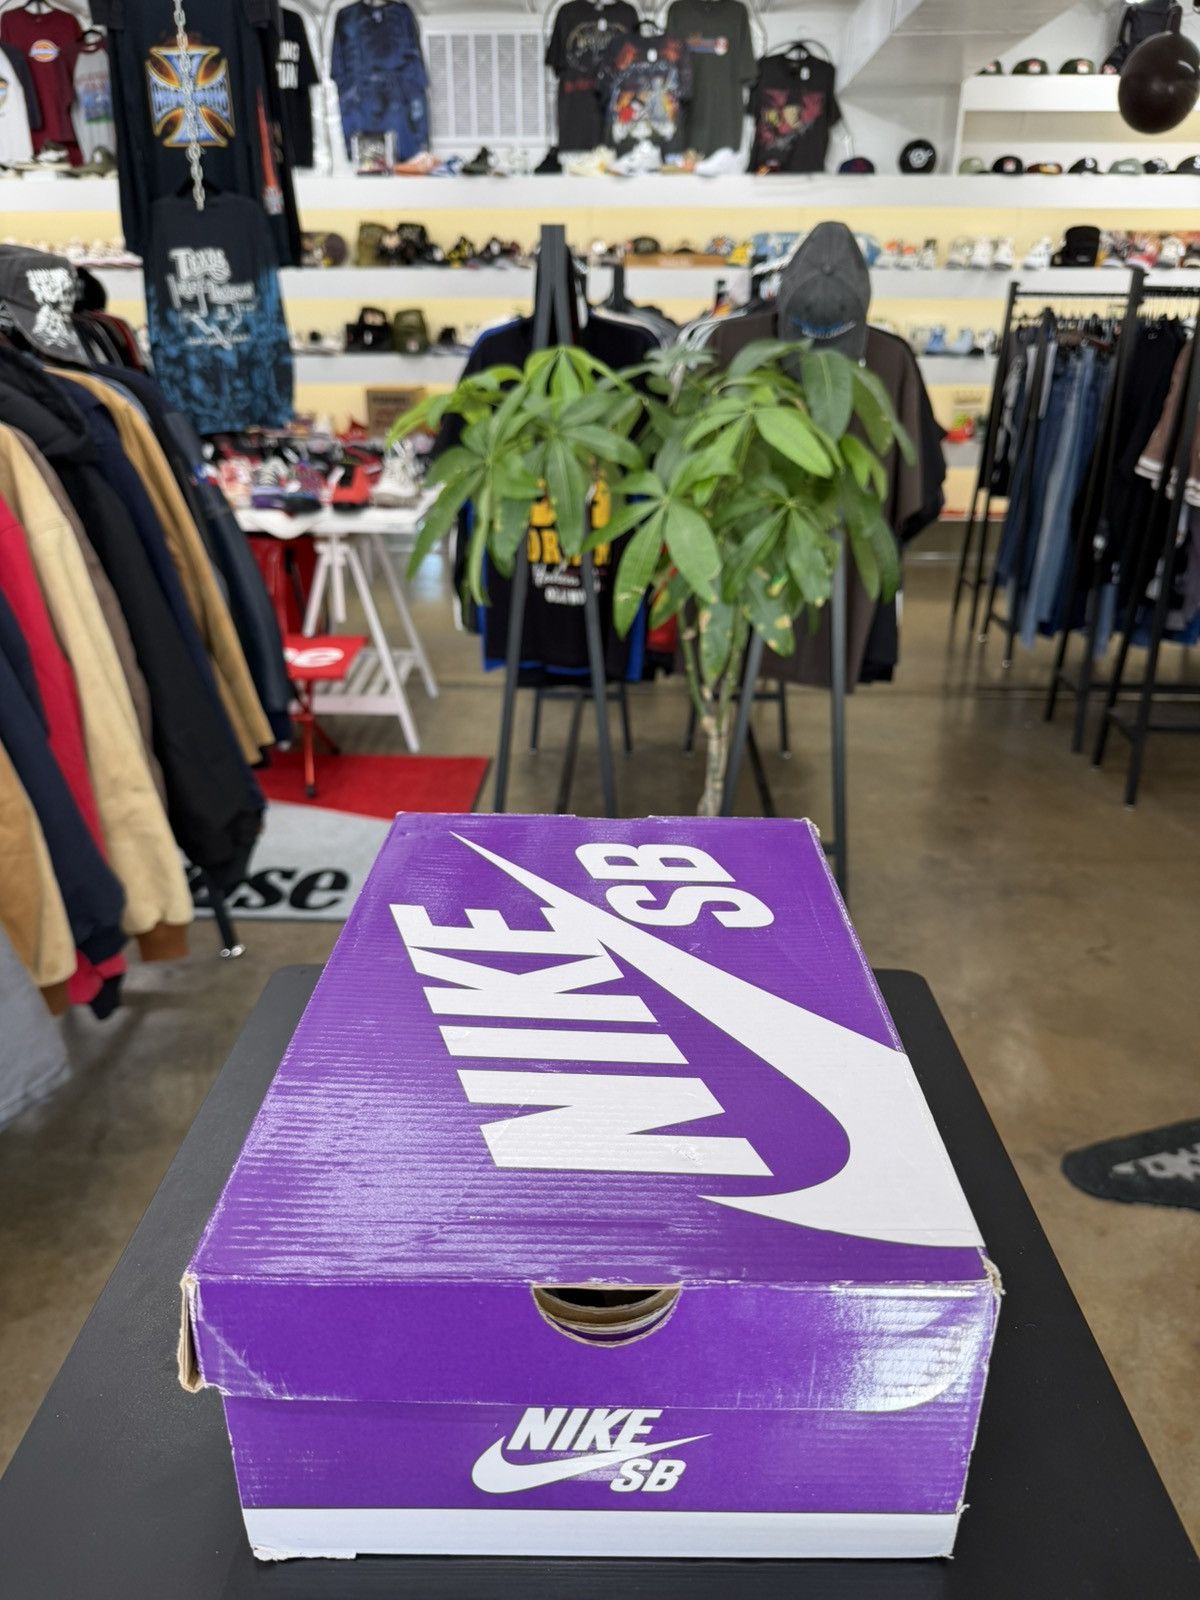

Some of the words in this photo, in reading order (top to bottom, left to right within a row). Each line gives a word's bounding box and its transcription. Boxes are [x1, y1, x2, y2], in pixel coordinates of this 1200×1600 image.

[575, 843, 775, 928] SB
[389, 904, 774, 1176] NIKE
[506, 1407, 663, 1450] NIKE
[610, 1458, 687, 1492] SB
